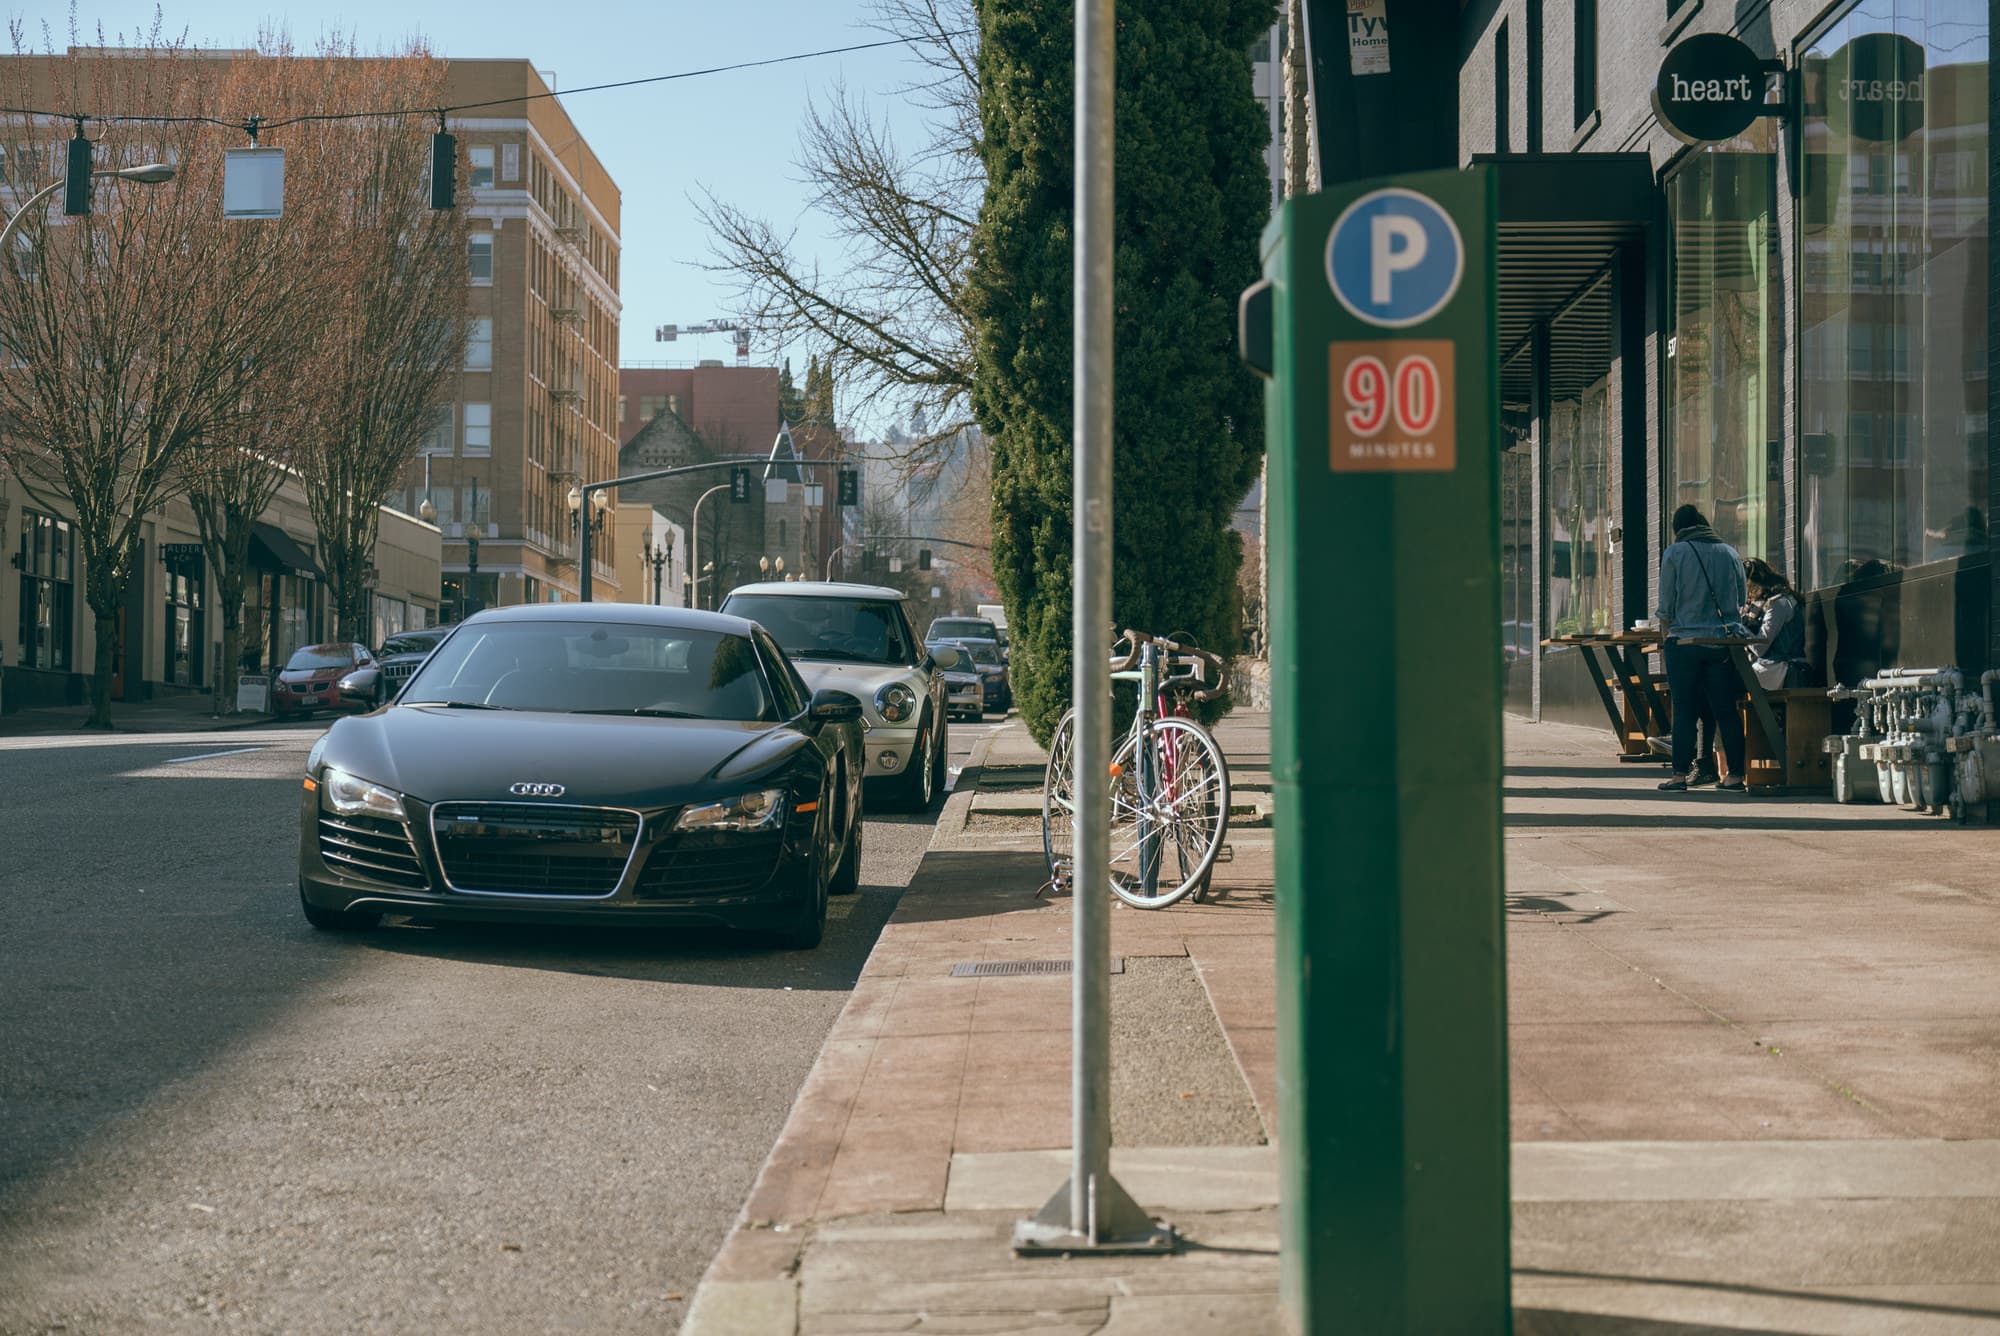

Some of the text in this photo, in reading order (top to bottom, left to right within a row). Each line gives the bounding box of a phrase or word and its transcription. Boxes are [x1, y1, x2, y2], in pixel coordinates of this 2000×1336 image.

[1352, 38, 1388, 47] Home
[1671, 73, 1752, 101] heart
[1371, 215, 1428, 304] P
[1343, 354, 1440, 437] 90
[1349, 443, 1436, 458] MINUTES
[167, 544, 201, 552] ALDER
